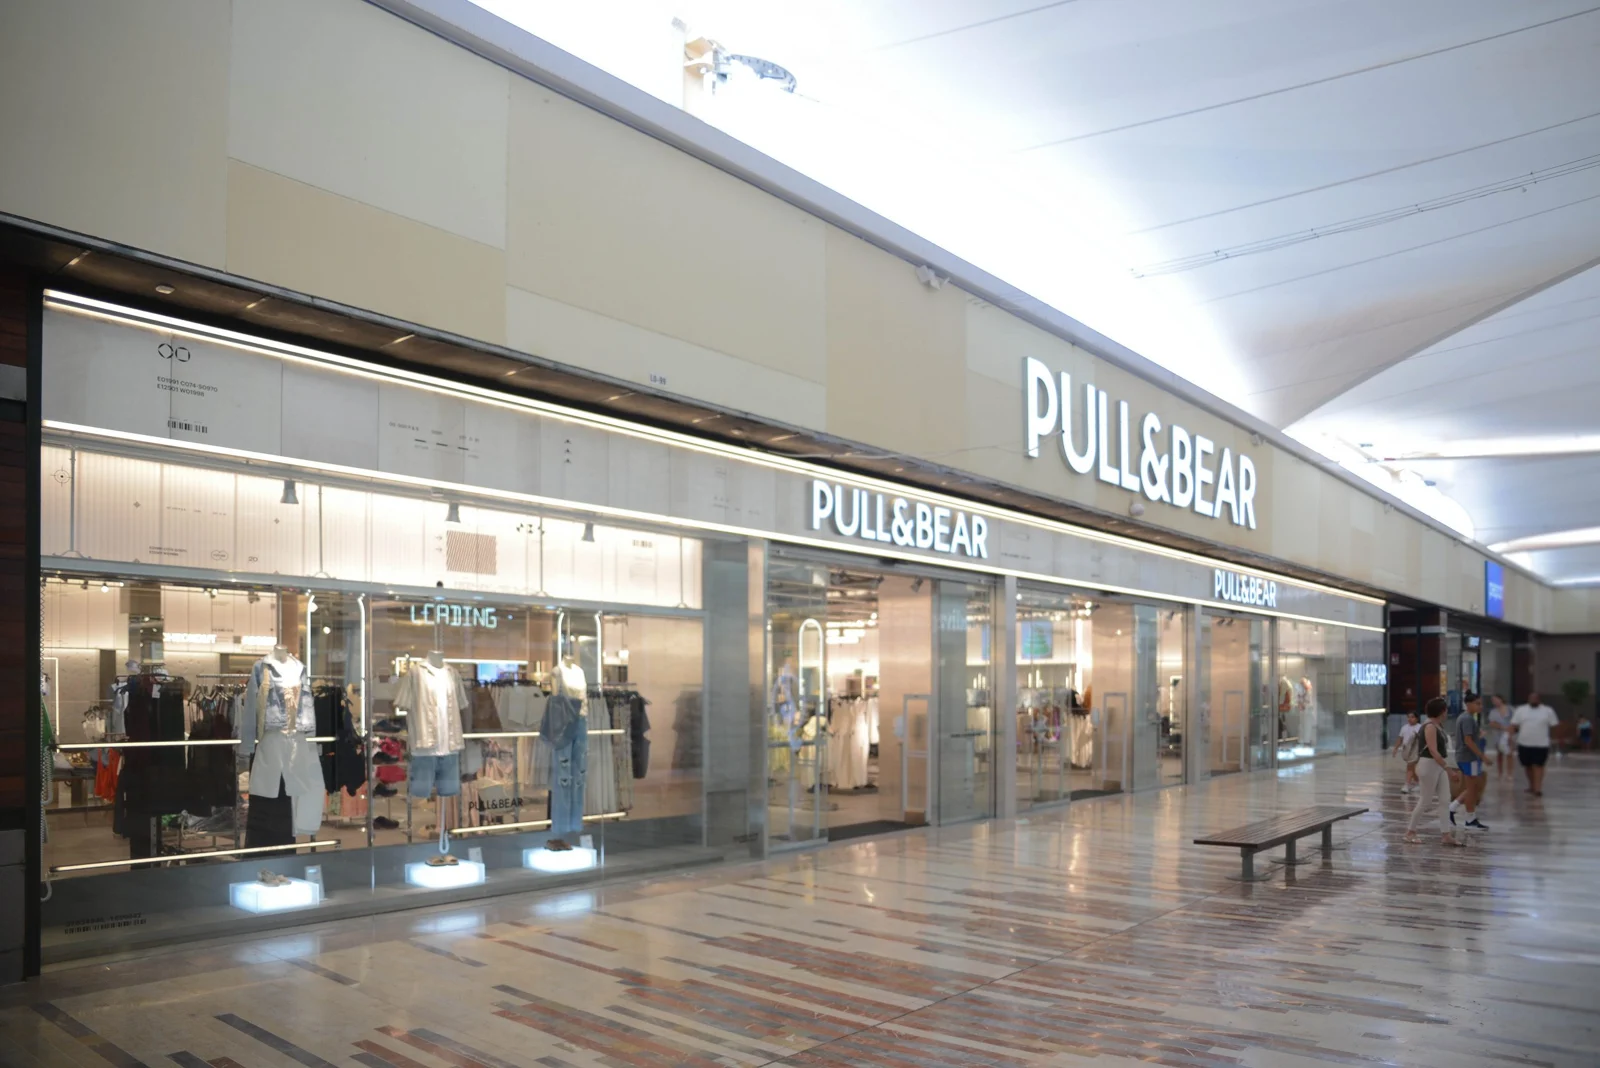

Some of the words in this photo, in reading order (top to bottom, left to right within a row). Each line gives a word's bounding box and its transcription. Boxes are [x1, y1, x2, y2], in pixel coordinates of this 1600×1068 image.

[1023, 356, 1257, 530] PULL&BEAR
[811, 479, 988, 559] PULL&BEAR
[1214, 569, 1277, 608] PULL&BEAR
[1351, 662, 1387, 685] PULL&BEAR
[469, 797, 524, 811] PULL&BEAR
